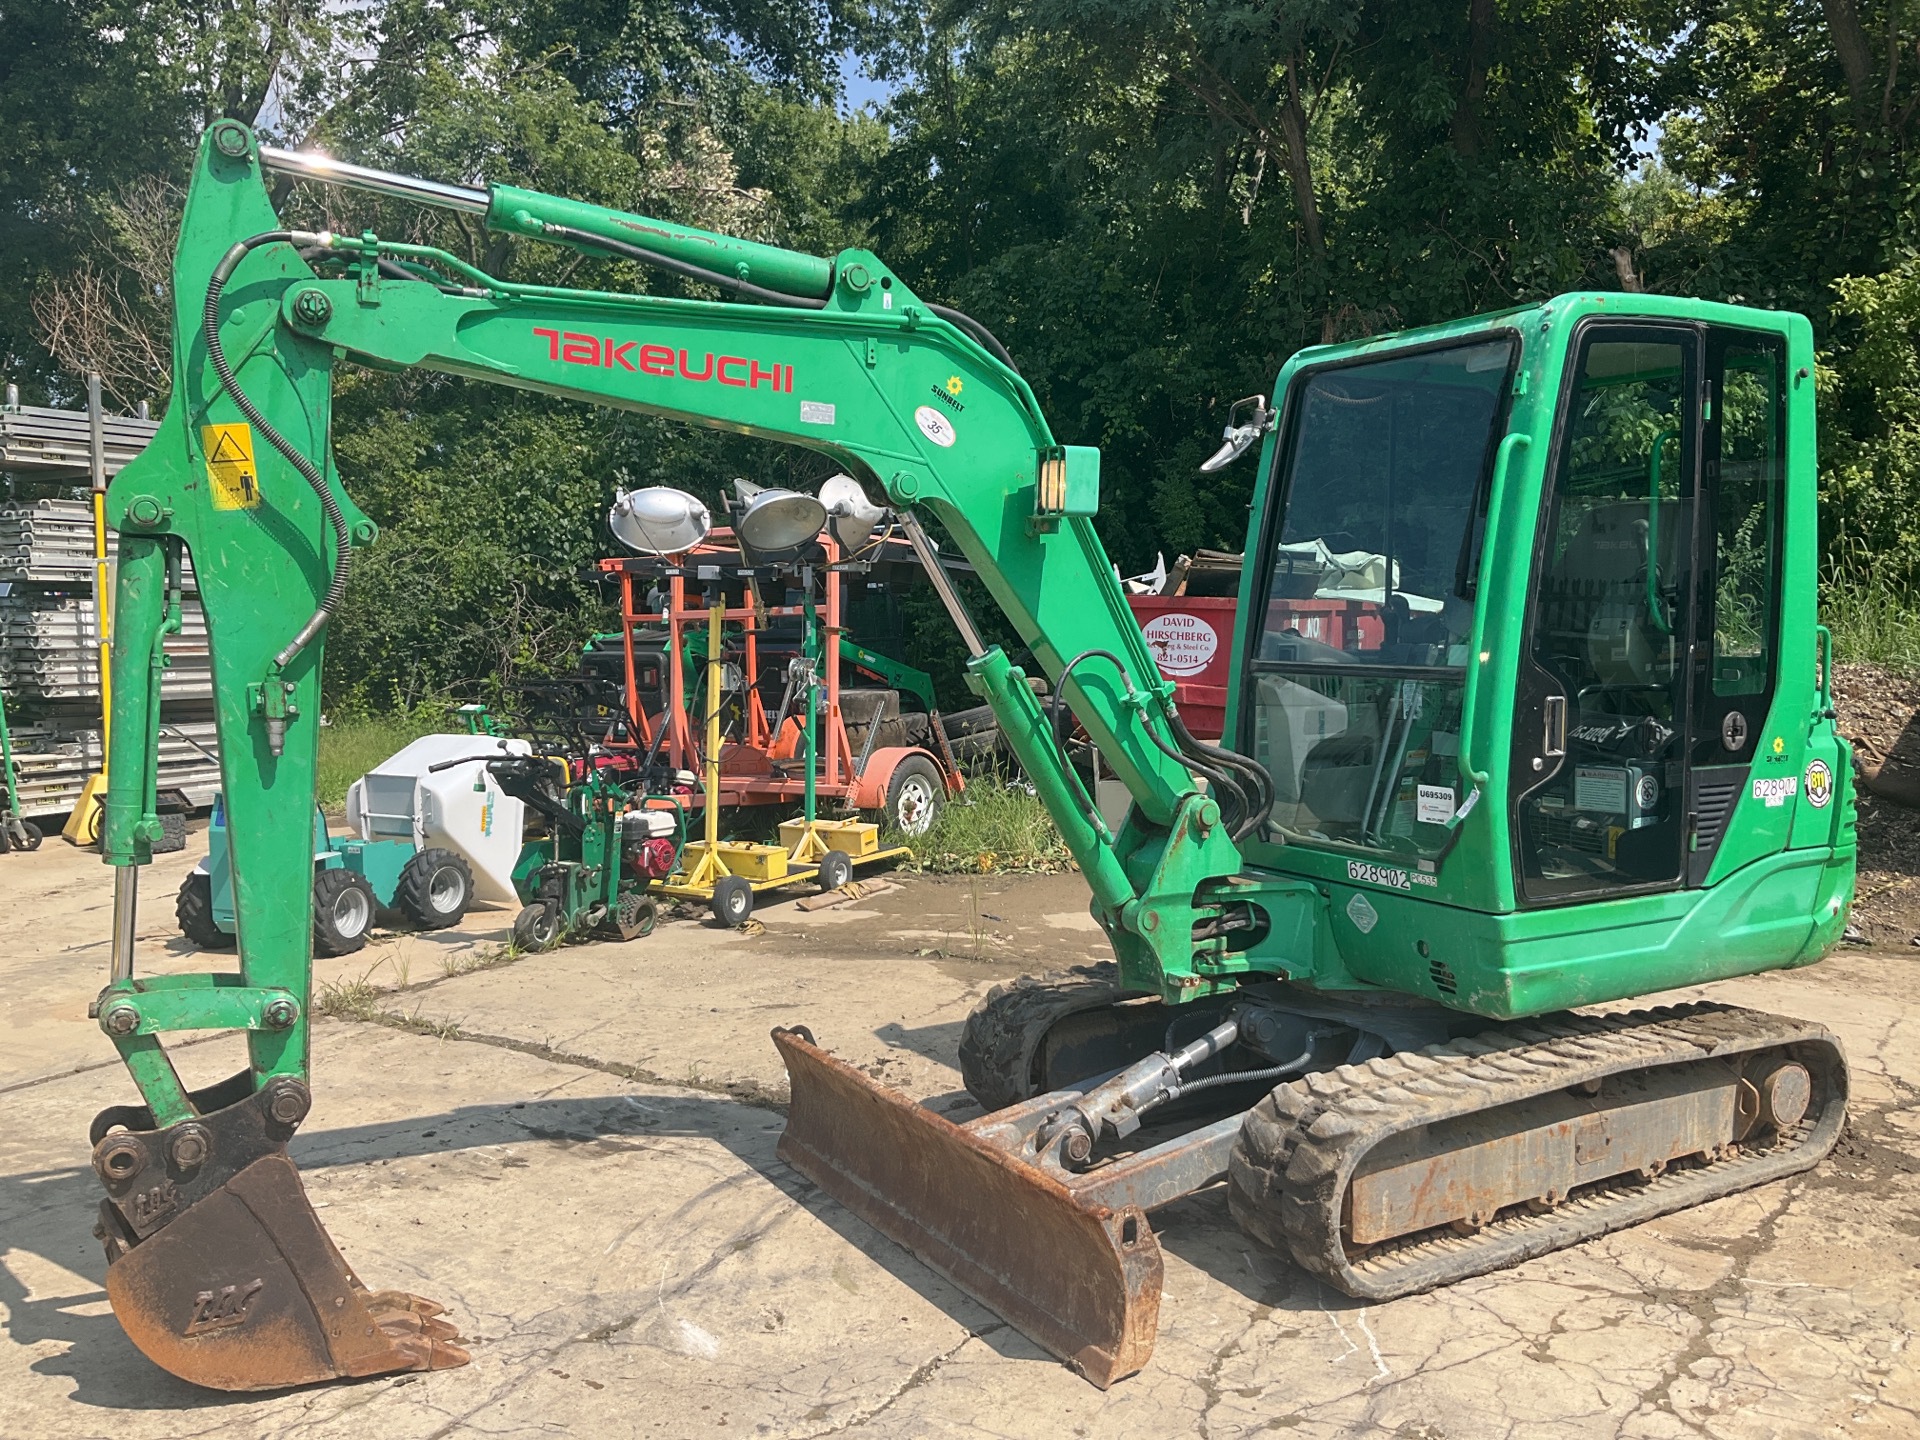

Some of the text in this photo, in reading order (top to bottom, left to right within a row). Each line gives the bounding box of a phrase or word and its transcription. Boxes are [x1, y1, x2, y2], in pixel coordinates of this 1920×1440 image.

[533, 327, 793, 393] TAKEUCHI
[931, 384, 965, 412] SUNBELT
[927, 421, 943, 434] 35
[1163, 617, 1195, 628] DAVID
[1146, 630, 1211, 642] HIRSCHBERG
[1183, 643, 1198, 651] Steel
[1157, 653, 1199, 664] 821-0514
[1811, 771, 1825, 789] 811
[1754, 778, 1796, 798] 628902
[1349, 861, 1410, 890] 628902
[1411, 873, 1437, 887] PC535
